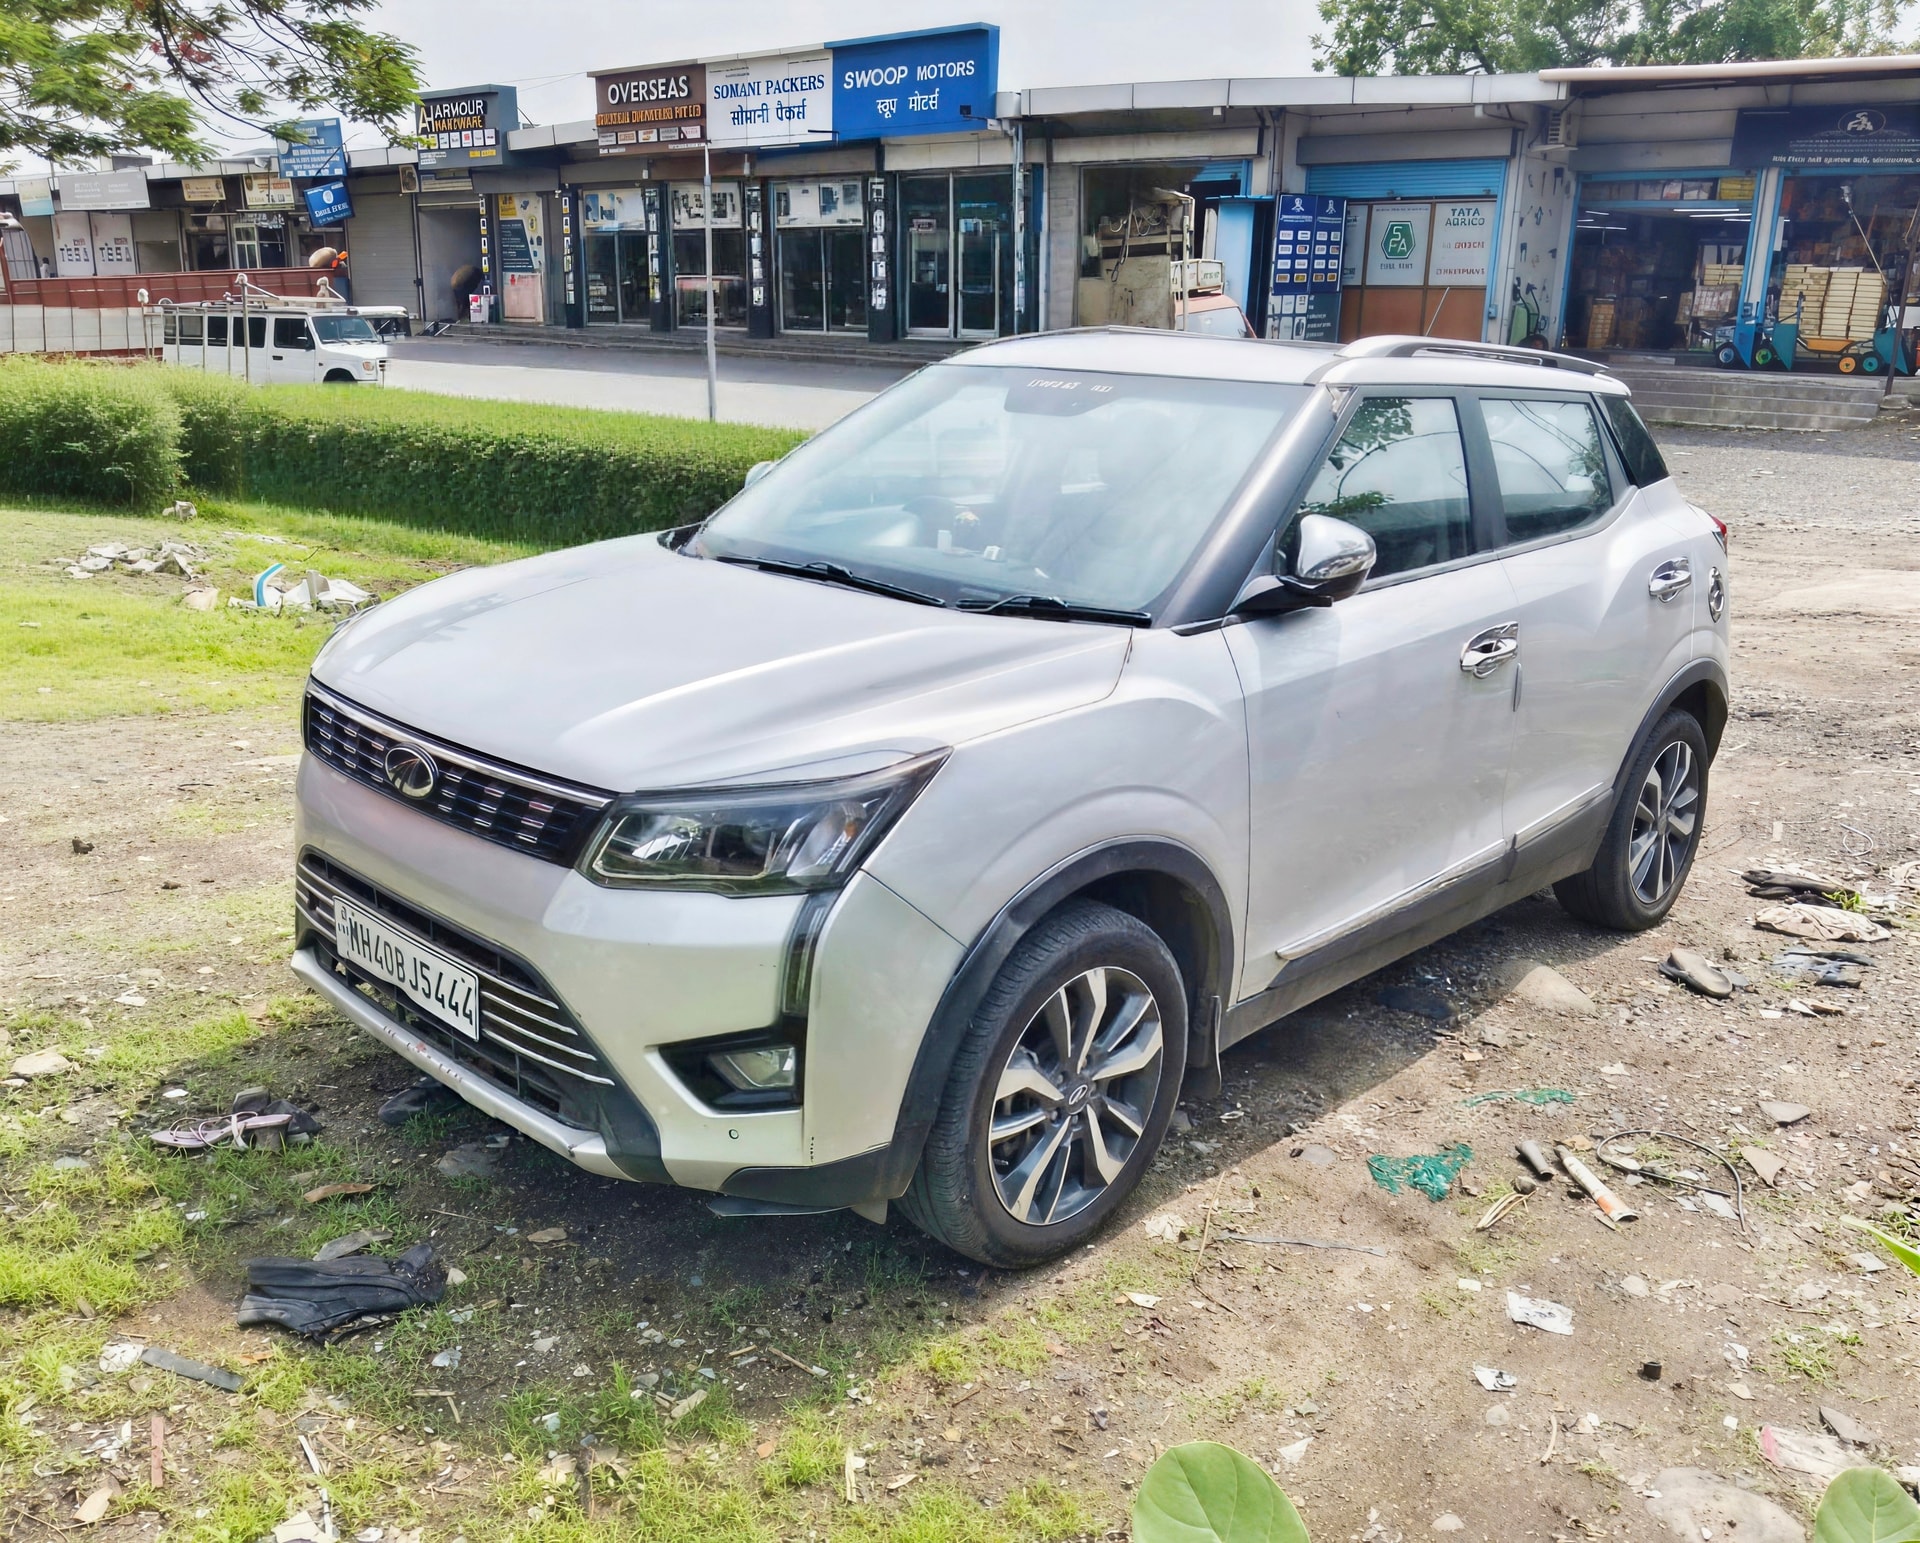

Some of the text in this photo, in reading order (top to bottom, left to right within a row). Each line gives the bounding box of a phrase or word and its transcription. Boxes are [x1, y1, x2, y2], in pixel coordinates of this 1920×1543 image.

[714, 74, 825, 100] SOMANI PACKERS
[843, 60, 975, 90] SWOOP MOTORS
[607, 75, 689, 105] OVERSEAS
[908, 88, 940, 111] मोटर्स
[730, 103, 770, 126] सोमानी
[1451, 208, 1480, 217] TATA
